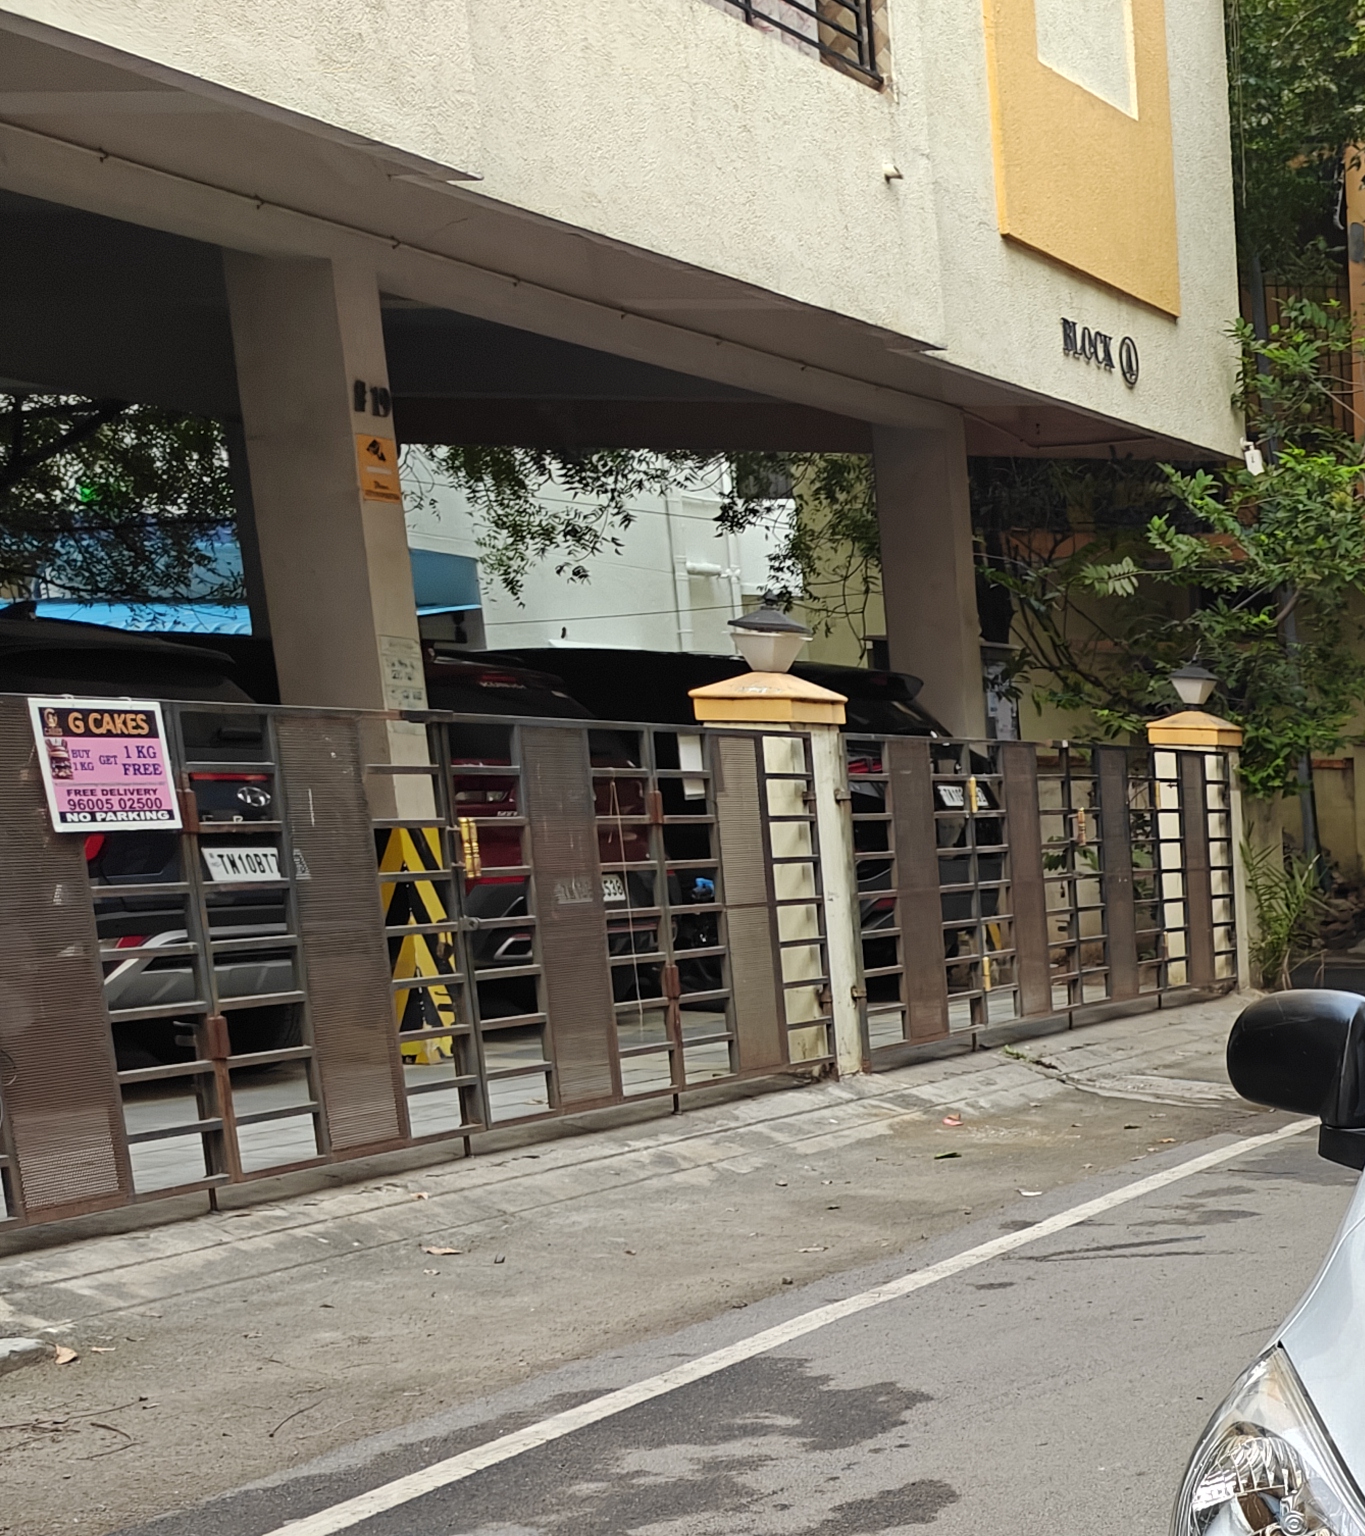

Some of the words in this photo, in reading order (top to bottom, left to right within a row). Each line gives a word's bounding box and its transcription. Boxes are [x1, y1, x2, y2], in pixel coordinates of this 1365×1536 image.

[1060, 317, 1116, 369] BLOCK
[68, 712, 85, 734] G
[88, 713, 149, 735] CAKES
[71, 750, 91, 759] BUY
[124, 746, 132, 759] 1
[135, 746, 157, 759] KG
[99, 755, 118, 765] GET
[80, 762, 94, 771] KG
[122, 763, 162, 776] FREE
[66, 789, 98, 797] FREE
[101, 788, 158, 797] DELIVERY
[67, 798, 114, 811] 96005
[118, 797, 163, 810] 02500
[65, 812, 92, 822] NO
[95, 811, 170, 821] PARKING
